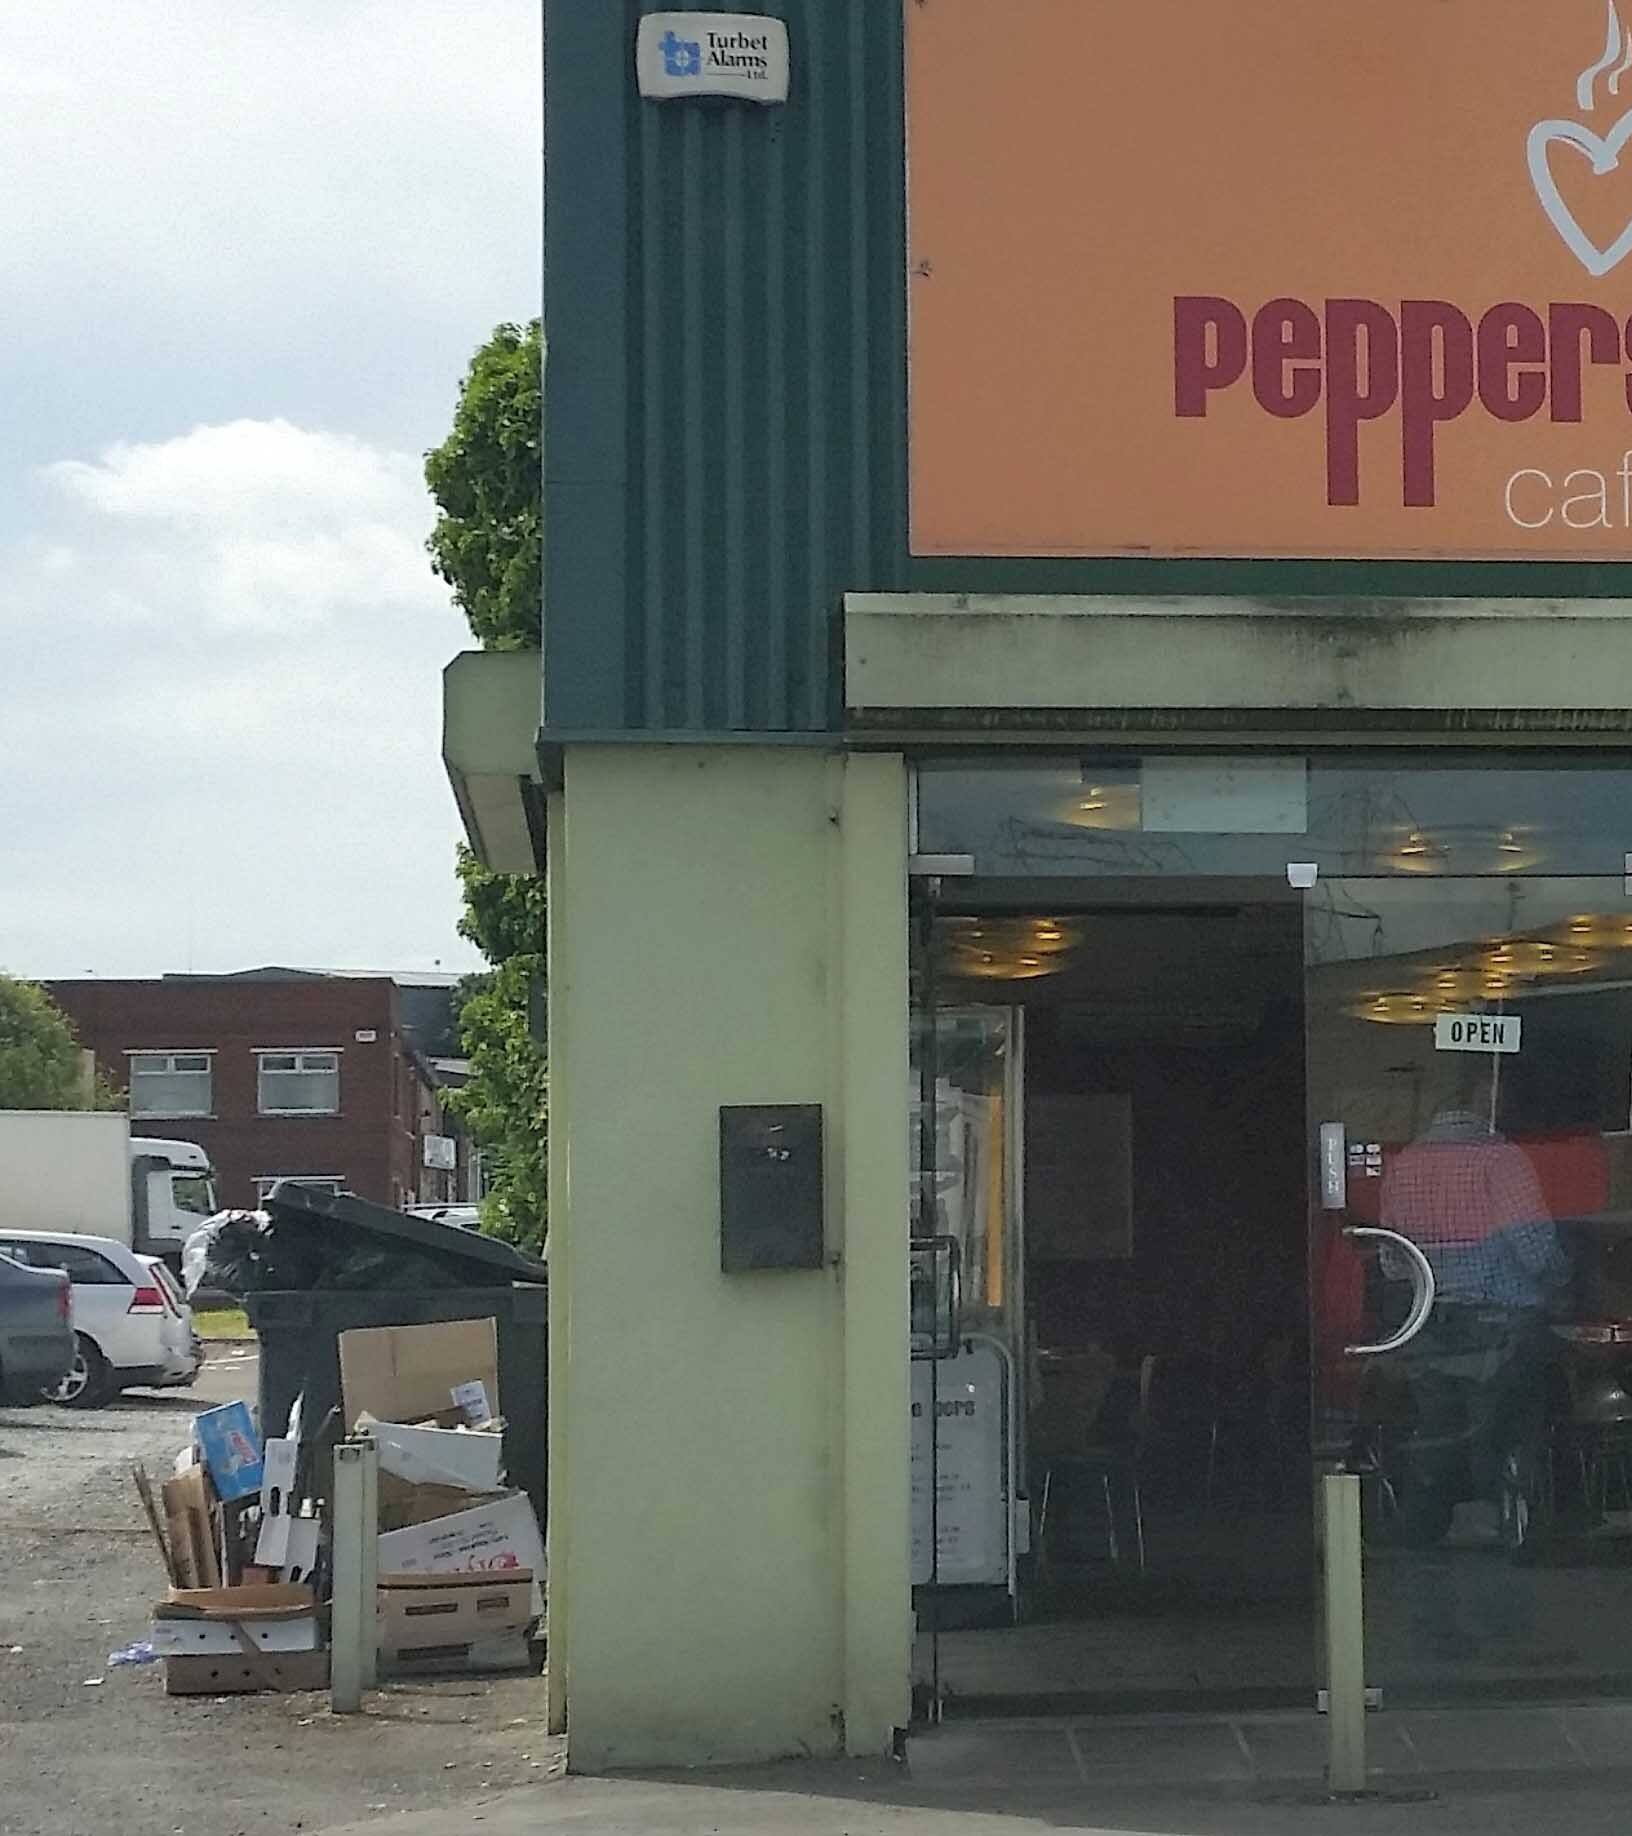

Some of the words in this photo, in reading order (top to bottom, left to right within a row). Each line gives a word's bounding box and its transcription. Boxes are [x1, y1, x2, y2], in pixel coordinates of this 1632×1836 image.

[706, 31, 768, 51] Turbet
[706, 51, 768, 68] Alarms
[1450, 1021, 1505, 1045] OPEN
